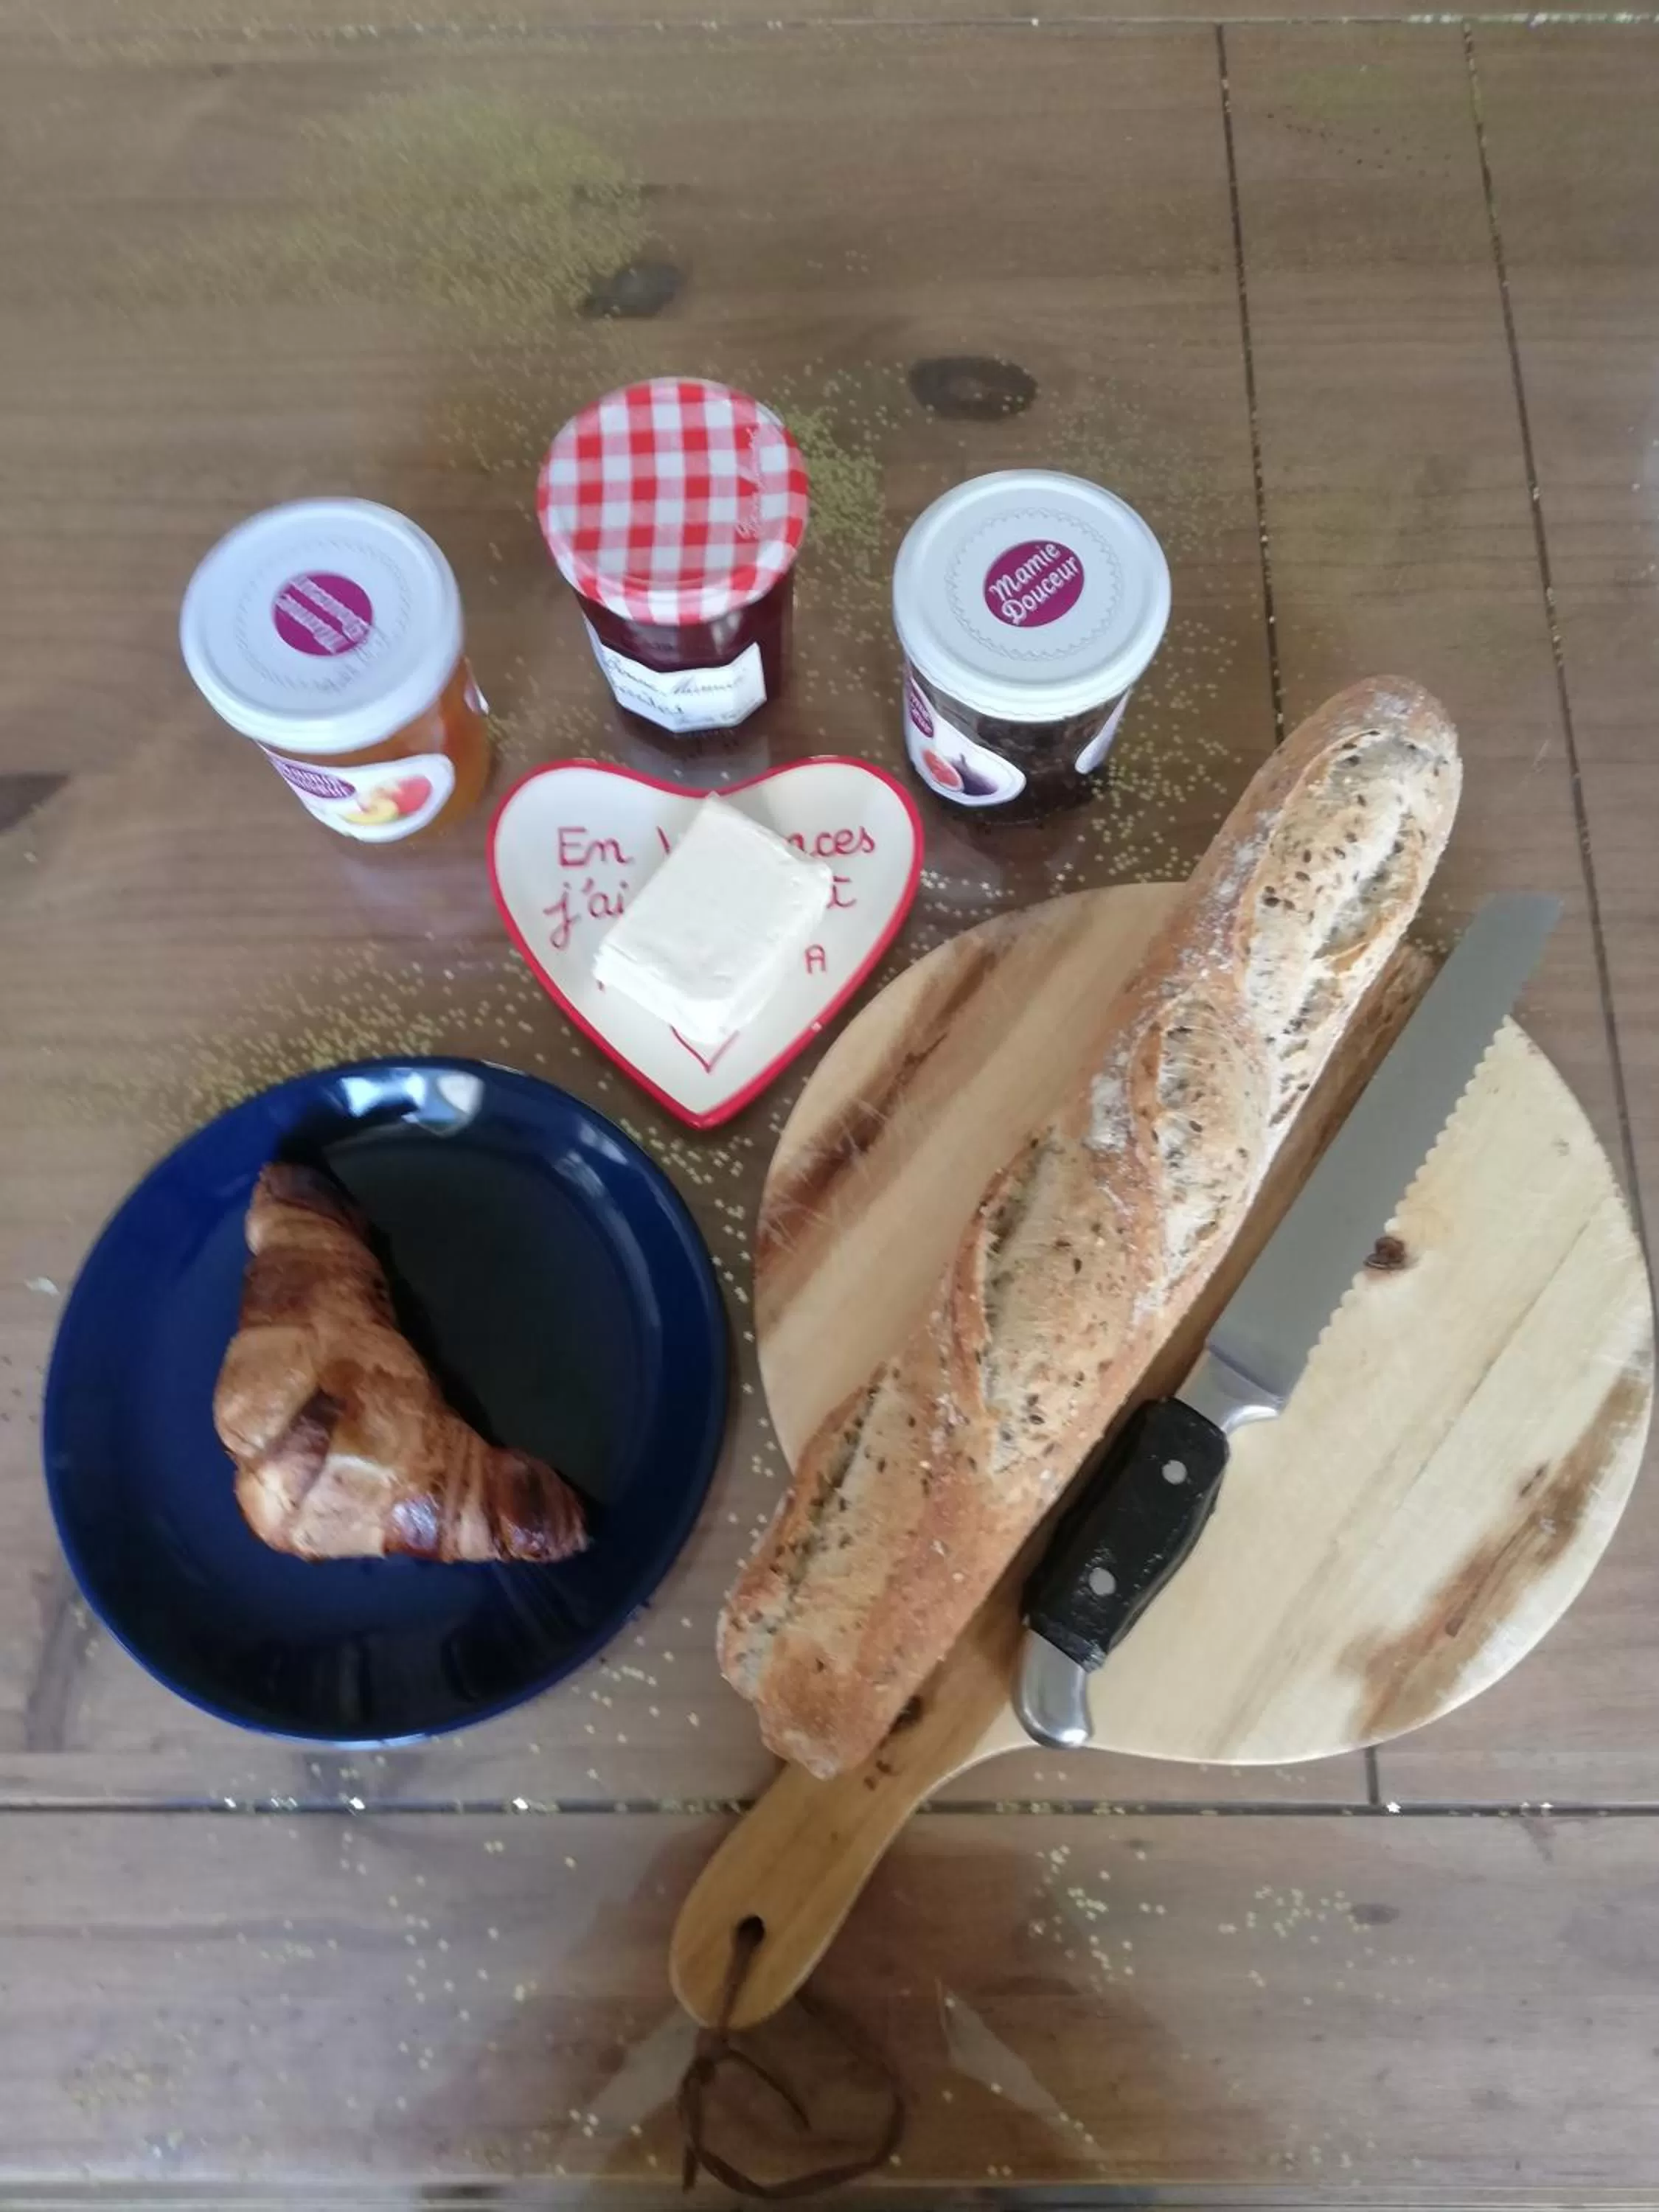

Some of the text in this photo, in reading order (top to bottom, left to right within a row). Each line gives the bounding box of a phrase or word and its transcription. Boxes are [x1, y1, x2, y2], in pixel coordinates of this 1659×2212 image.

[989, 543, 1060, 602] Mamie
[1001, 557, 1079, 625] Douceur
[557, 827, 635, 866] En
[543, 877, 628, 948] j'ai
